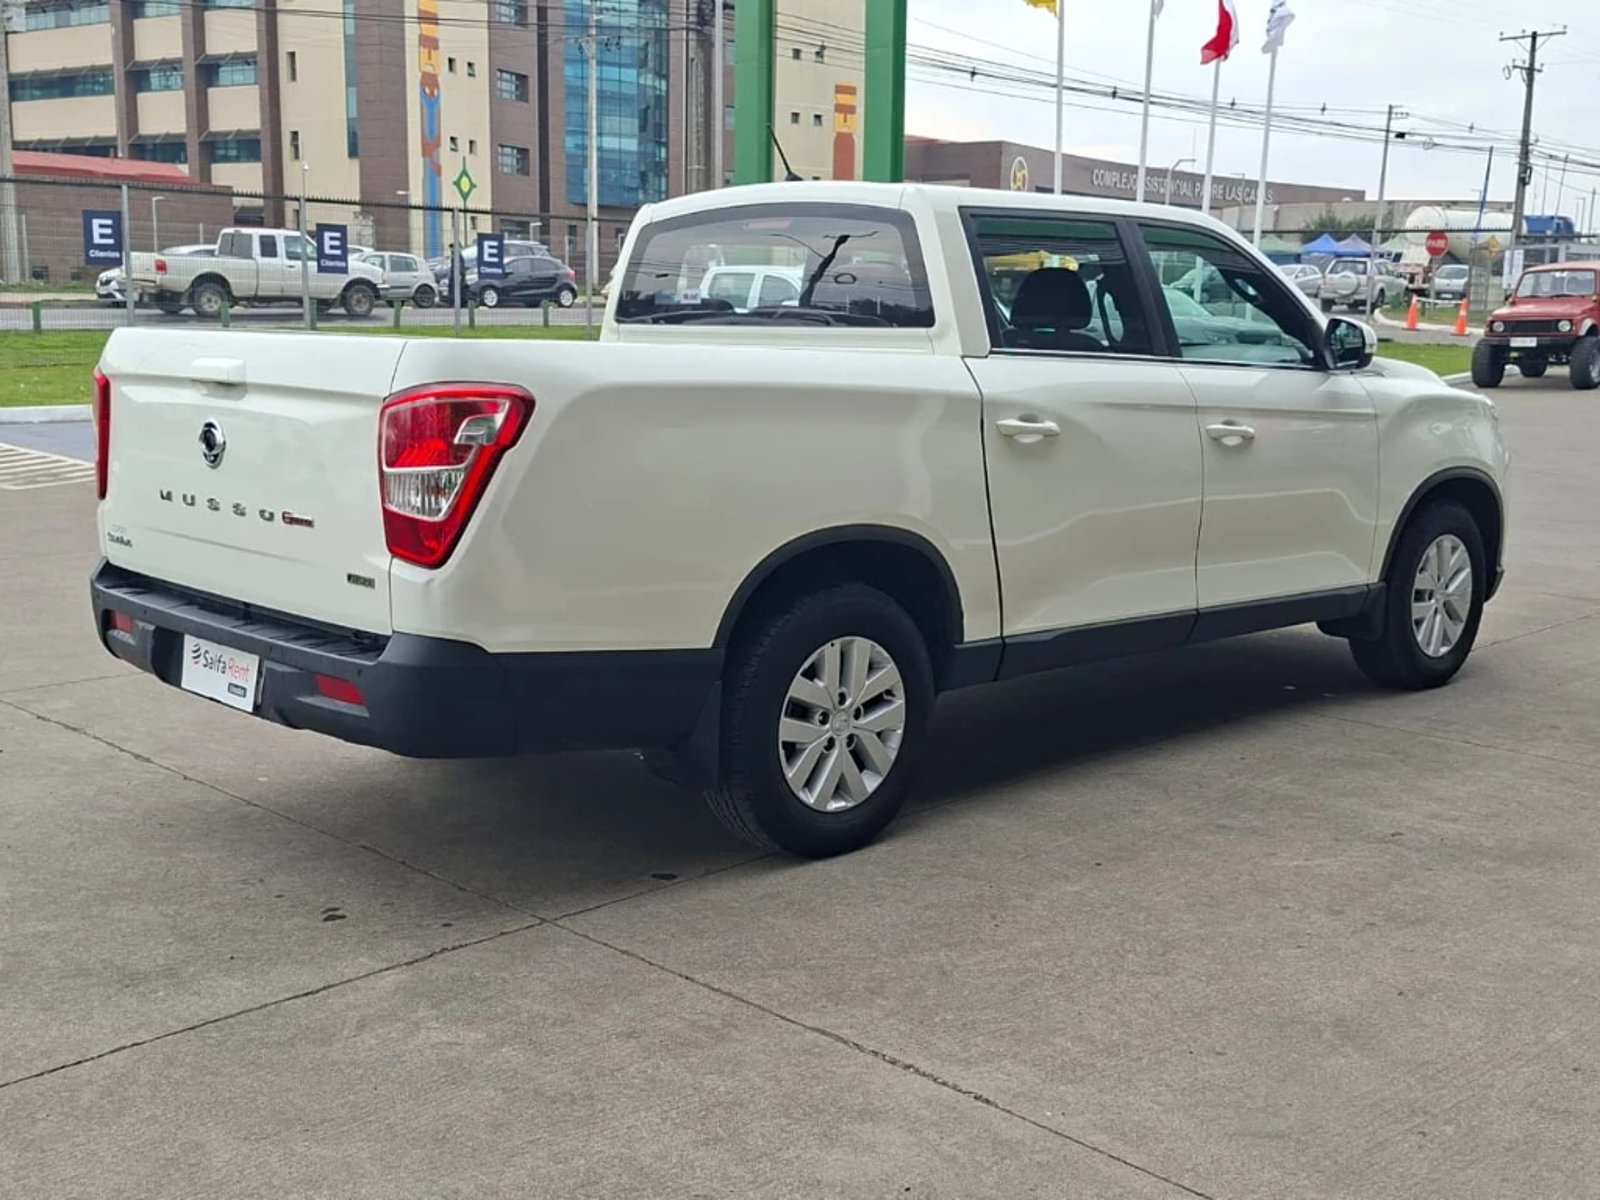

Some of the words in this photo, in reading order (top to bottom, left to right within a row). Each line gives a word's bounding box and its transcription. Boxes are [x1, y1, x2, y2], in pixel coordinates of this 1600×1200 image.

[1143, 175, 1193, 198] SISTENCIAL
[1194, 182, 1224, 200] PRE
[1243, 187, 1273, 203] CAS
[91, 218, 115, 244] E
[323, 231, 342, 255] E
[483, 240, 499, 262] E
[159, 489, 275, 523] MUSSO
